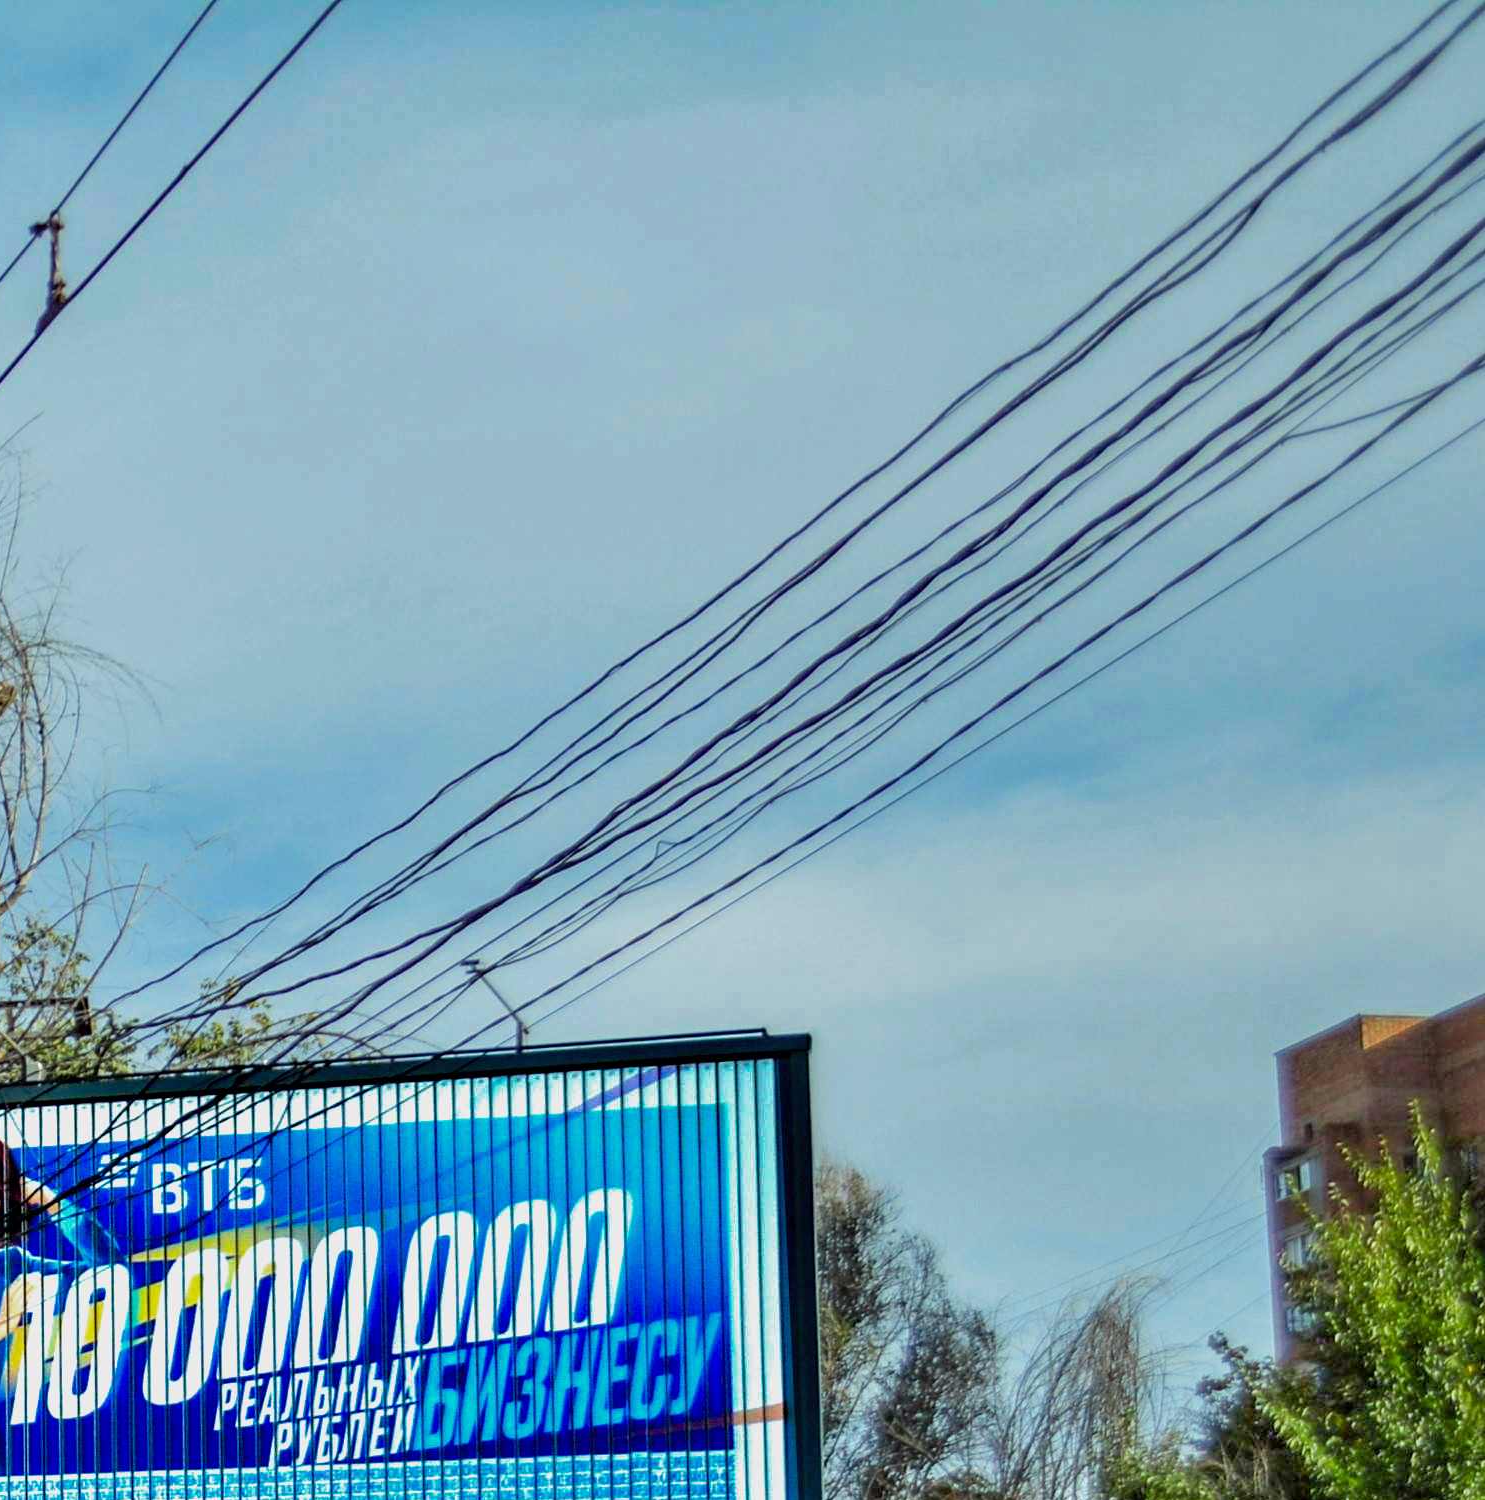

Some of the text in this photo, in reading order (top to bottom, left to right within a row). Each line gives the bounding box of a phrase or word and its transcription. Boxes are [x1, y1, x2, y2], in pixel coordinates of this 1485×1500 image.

[150, 1157, 267, 1215] ВТБ
[10, 1188, 633, 1424] 10 000 000
[213, 1354, 424, 1432] РЕАЛЬНЫХ
[413, 1309, 720, 1450] БИЗНЕСУ
[267, 1398, 419, 1470] РУБЛЕЙ
